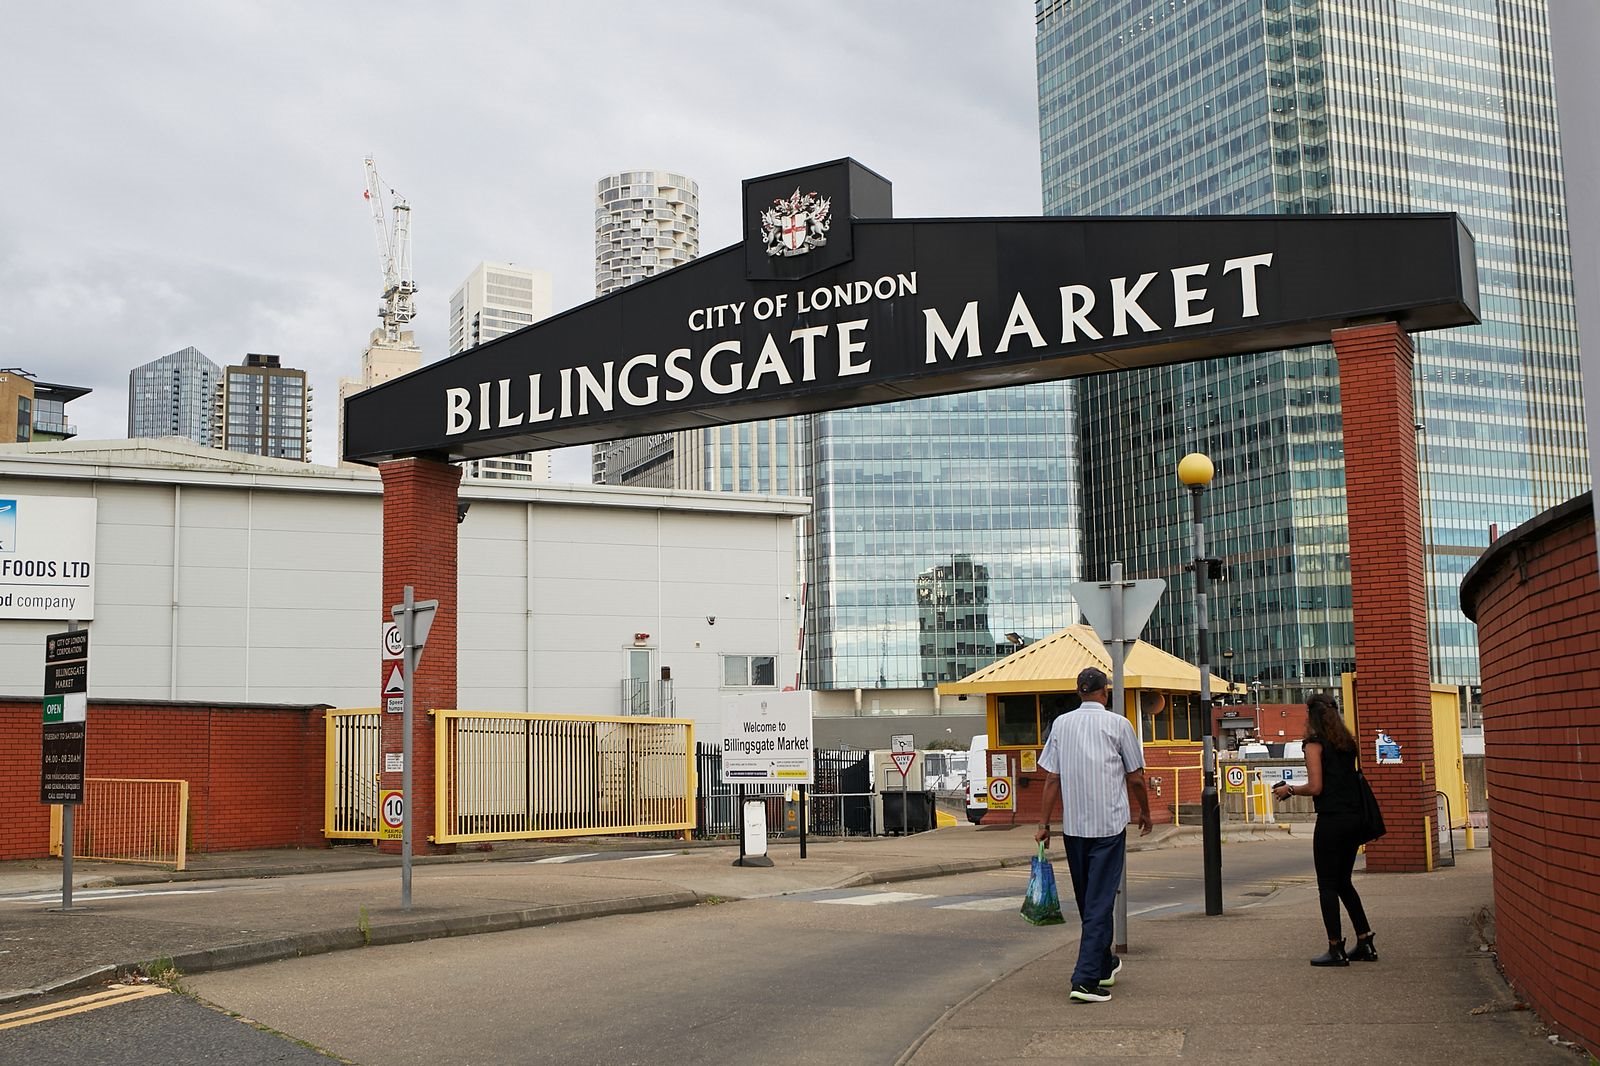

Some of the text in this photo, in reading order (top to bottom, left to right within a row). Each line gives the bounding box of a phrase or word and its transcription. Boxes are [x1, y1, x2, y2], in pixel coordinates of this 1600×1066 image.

[688, 271, 918, 332] CITY OF LONDON
[445, 252, 1274, 436] BILLINGSGATE MARKET
[2, 560, 90, 578] FOODS LTD
[17, 596, 76, 611] company
[56, 635, 86, 647] CITY OF LONDON
[390, 631, 402, 644] 10
[56, 645, 82, 655] CORPORATION
[55, 665, 85, 689] BILLINGSGATE MARKET
[46, 703, 62, 714] OPEN
[743, 721, 787, 733] Welcome to
[44, 733, 59, 741] TUESDAY
[60, 732, 65, 740] TO
[724, 736, 809, 755] Billingsgate Market
[1230, 770, 1242, 780] 10
[992, 783, 1007, 794] 10
[387, 799, 403, 816] 10
